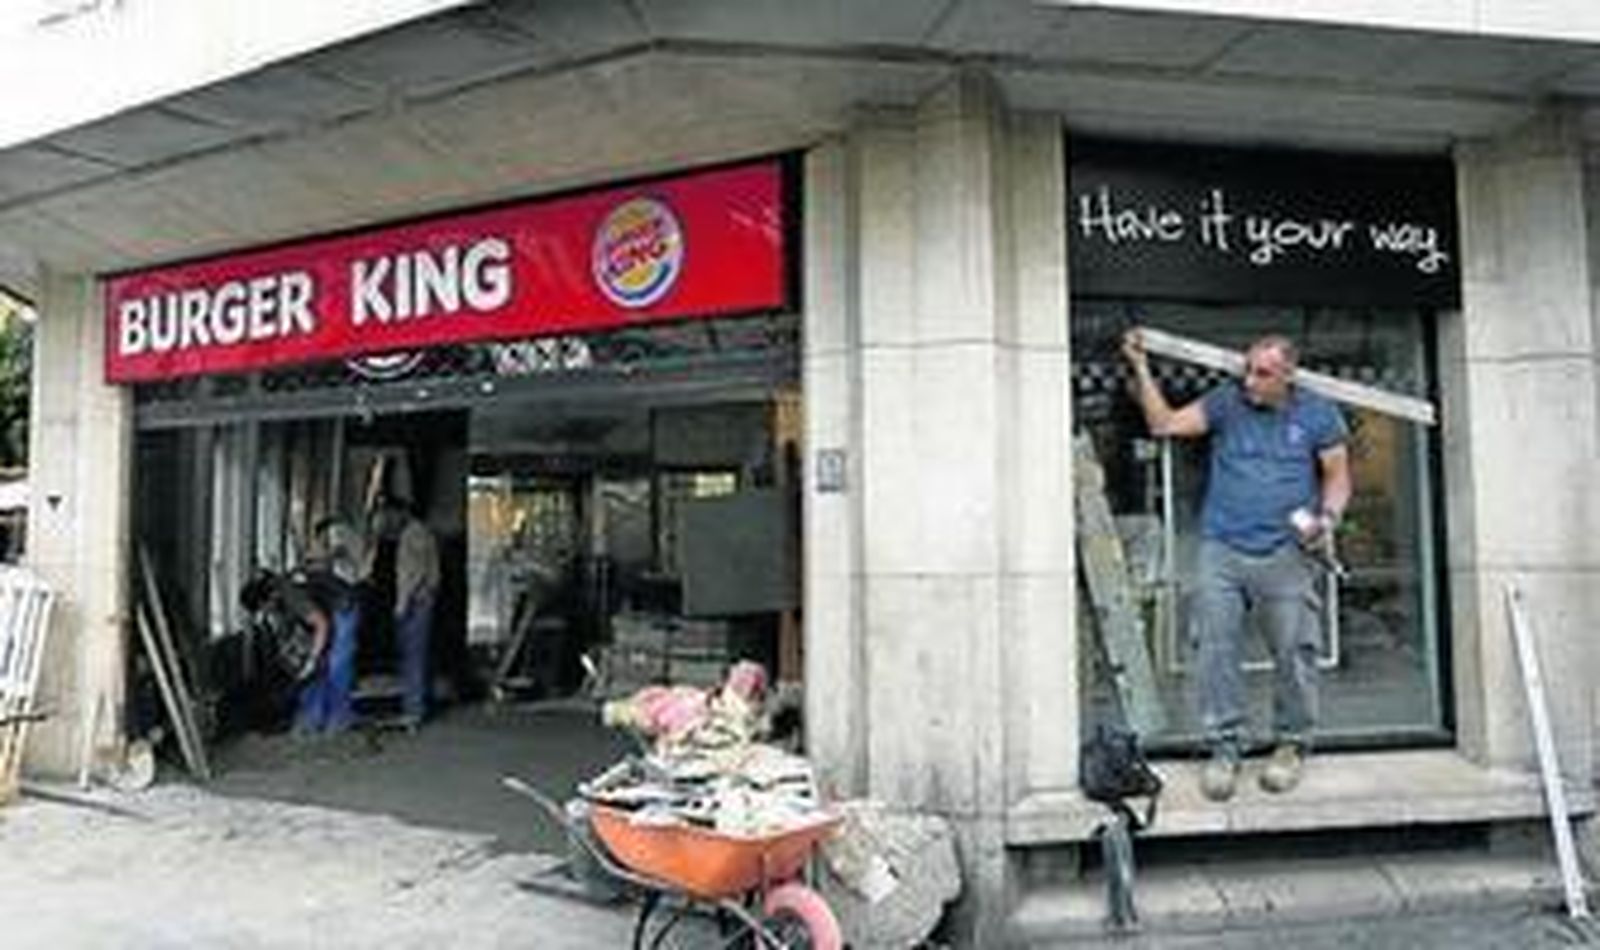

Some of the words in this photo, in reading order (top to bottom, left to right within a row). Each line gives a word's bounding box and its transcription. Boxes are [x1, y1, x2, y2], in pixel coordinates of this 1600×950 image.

[1079, 185, 1183, 243] Have
[1200, 188, 1231, 250] it
[1245, 216, 1354, 265] your
[1369, 224, 1449, 273] way
[119, 272, 314, 357] BURGER
[350, 238, 511, 326] KING
